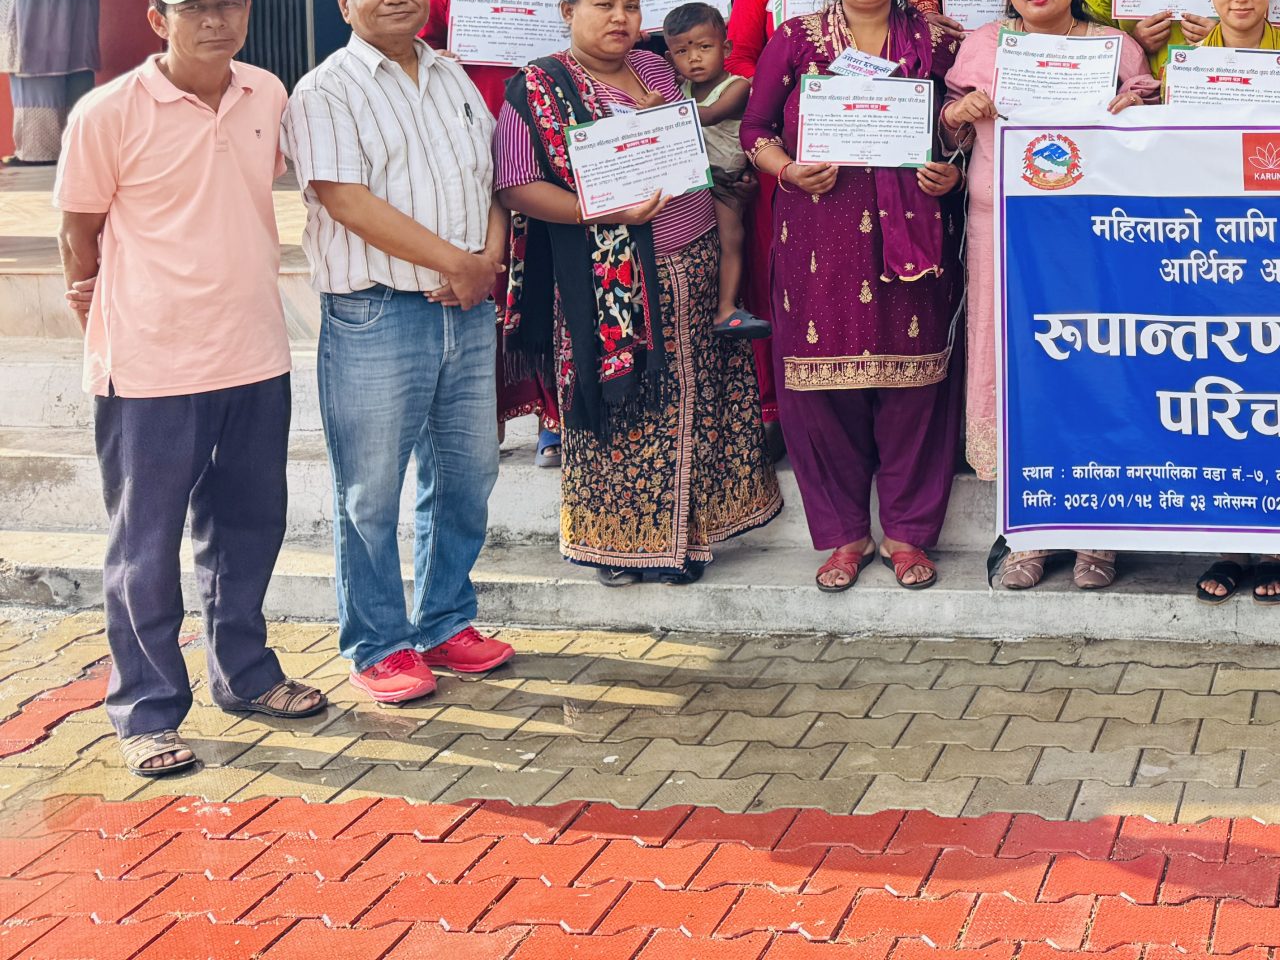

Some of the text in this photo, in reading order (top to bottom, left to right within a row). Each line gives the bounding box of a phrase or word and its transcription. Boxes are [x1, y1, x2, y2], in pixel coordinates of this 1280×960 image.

[1091, 207, 1202, 243] महिलाको
[1215, 208, 1277, 243] लागि
[1159, 249, 1247, 284] आर्थिक
[1022, 465, 1054, 481] स्थान
[1072, 461, 1121, 480] कालिका
[1126, 462, 1197, 480] नगरपालिका
[1203, 467, 1226, 481] वडा
[1159, 490, 1184, 509] देखि
[1190, 494, 1206, 511] २३
[1213, 493, 1258, 510] गतेसम्म
